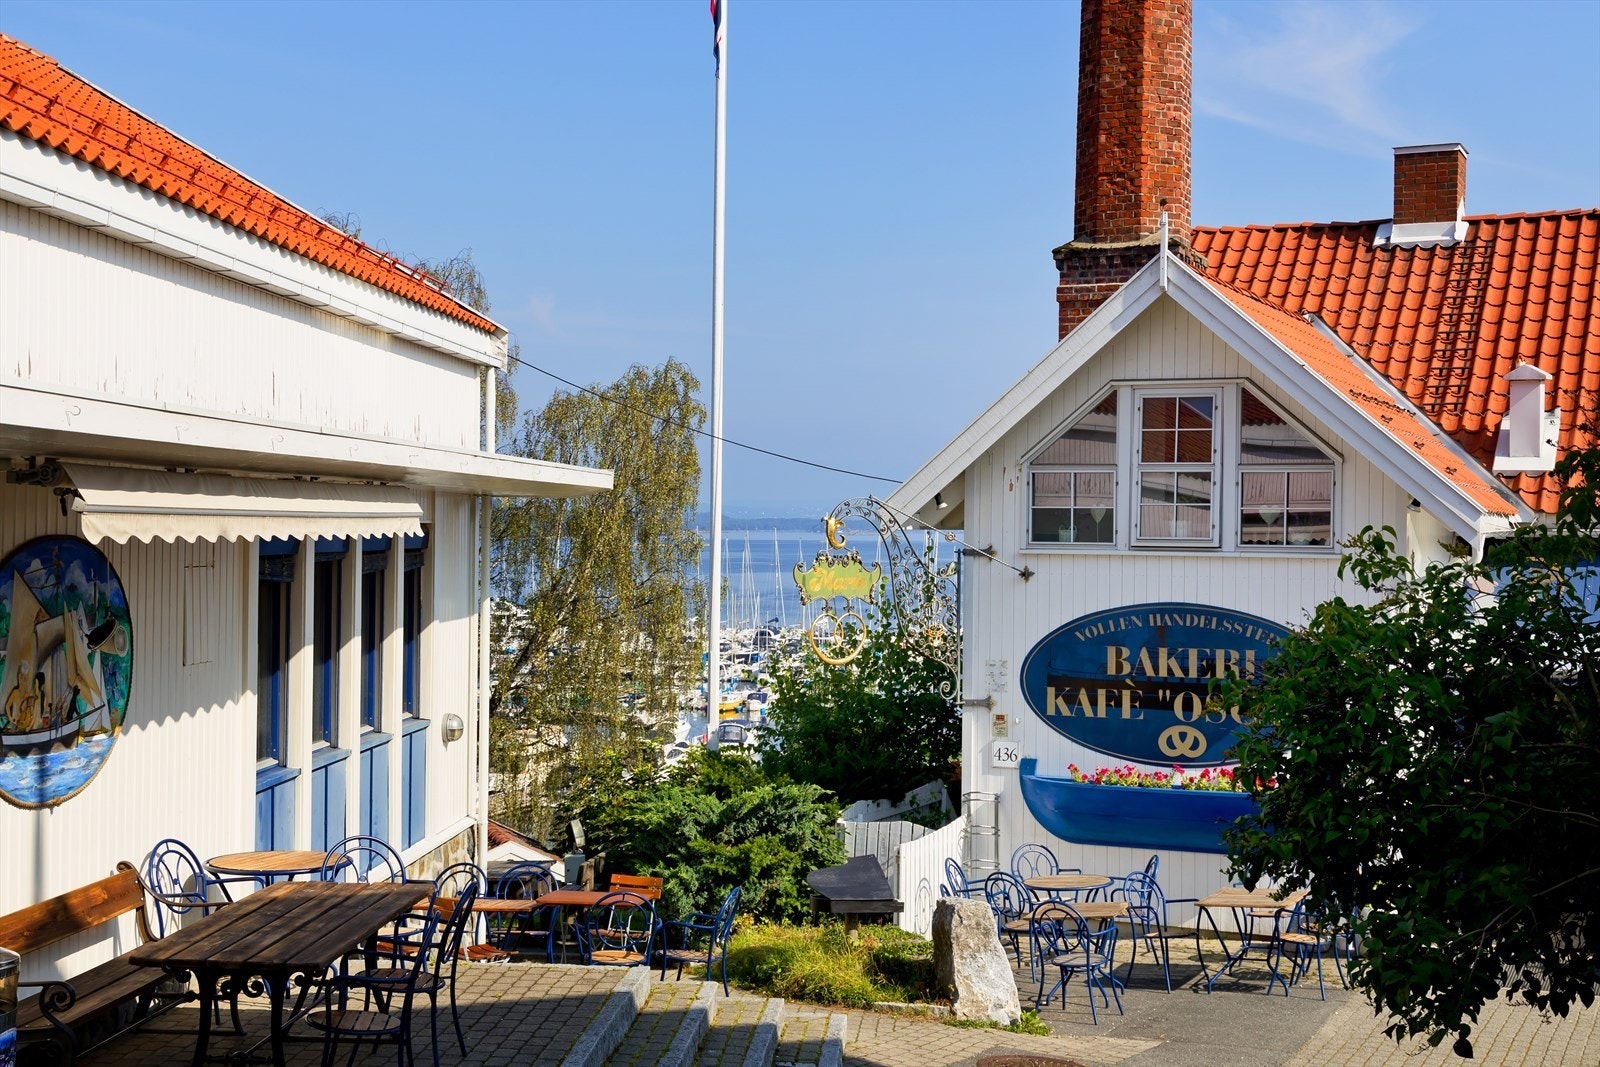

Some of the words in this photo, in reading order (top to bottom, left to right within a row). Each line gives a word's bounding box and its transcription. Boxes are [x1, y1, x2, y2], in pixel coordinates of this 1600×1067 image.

[1074, 614, 1143, 642] VOLLEN
[1104, 645, 1257, 681] BAKERI
[993, 747, 1018, 763] 436
